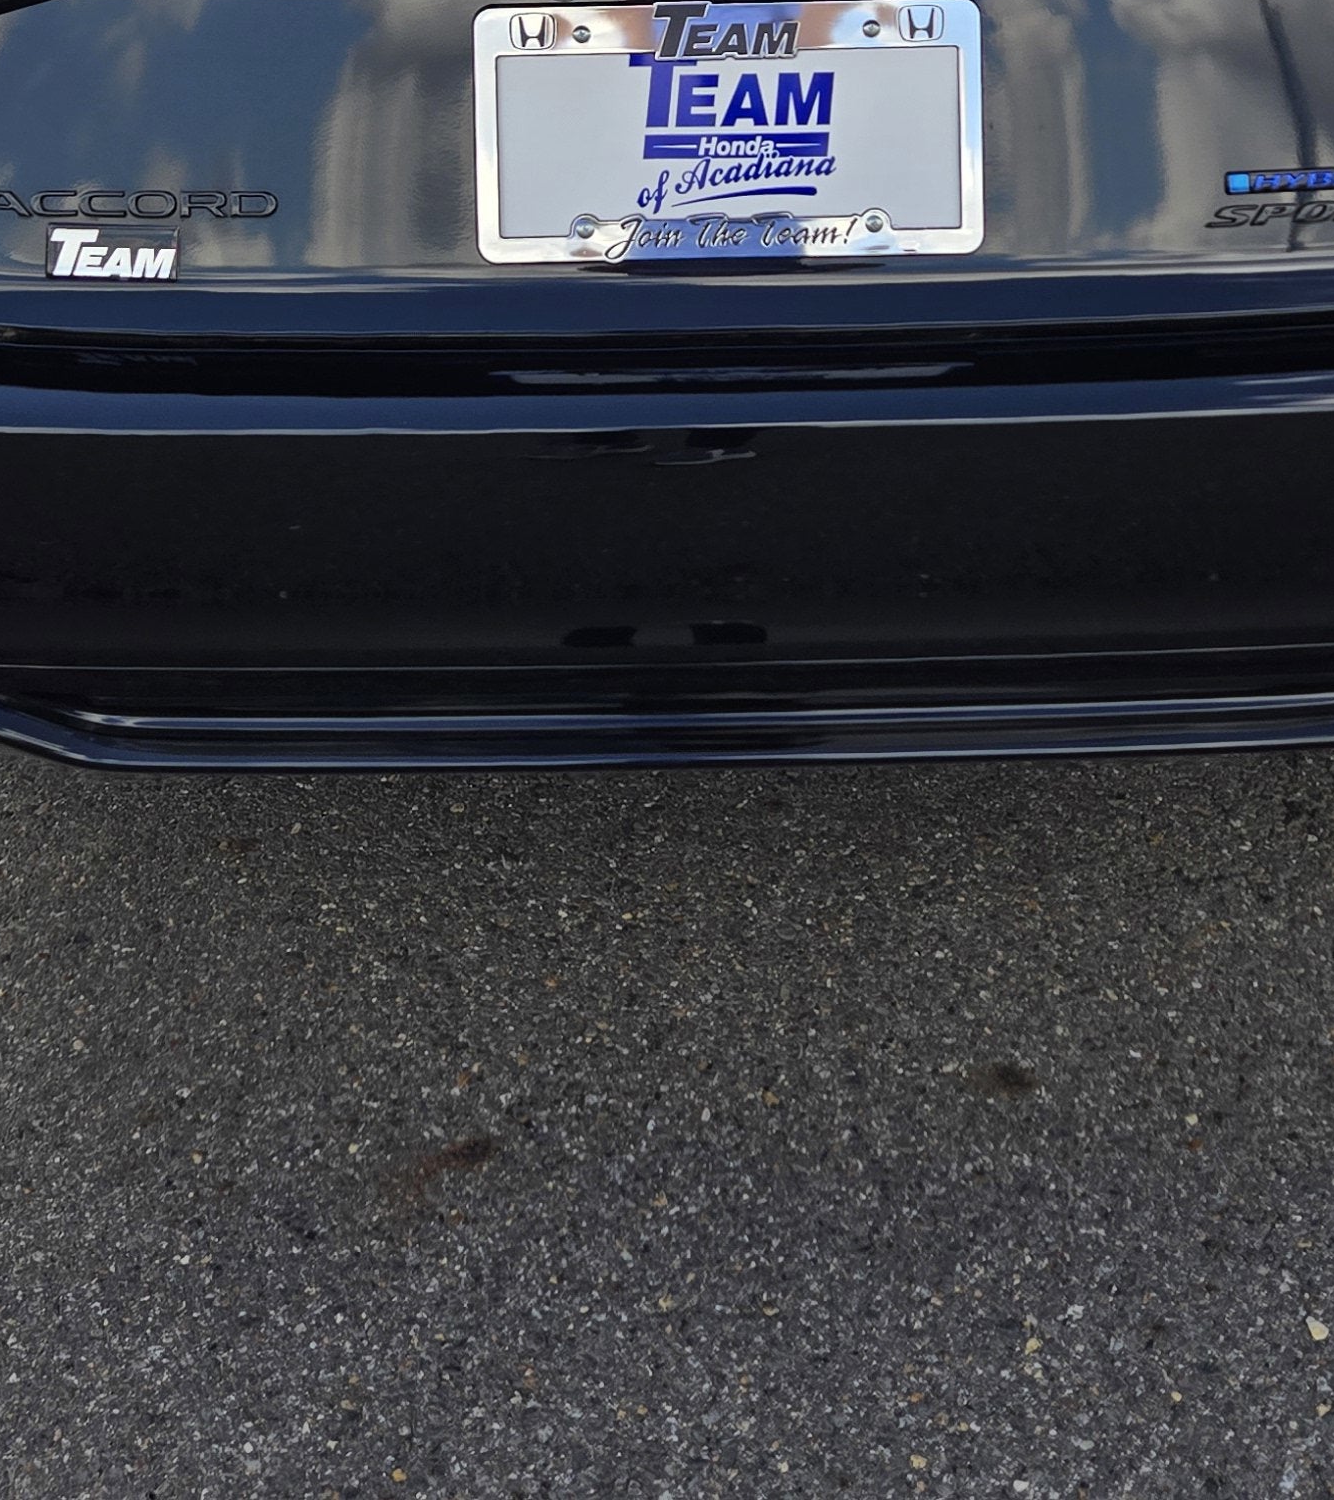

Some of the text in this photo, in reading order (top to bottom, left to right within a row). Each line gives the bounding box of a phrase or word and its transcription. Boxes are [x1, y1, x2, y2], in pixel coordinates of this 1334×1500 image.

[655, 4, 799, 58] TEAM
[629, 53, 836, 129] TEAM
[698, 136, 775, 158] Honda
[636, 152, 837, 214] of Acadiana
[50, 228, 177, 279] TEAM
[605, 213, 858, 260] Join The Team!
